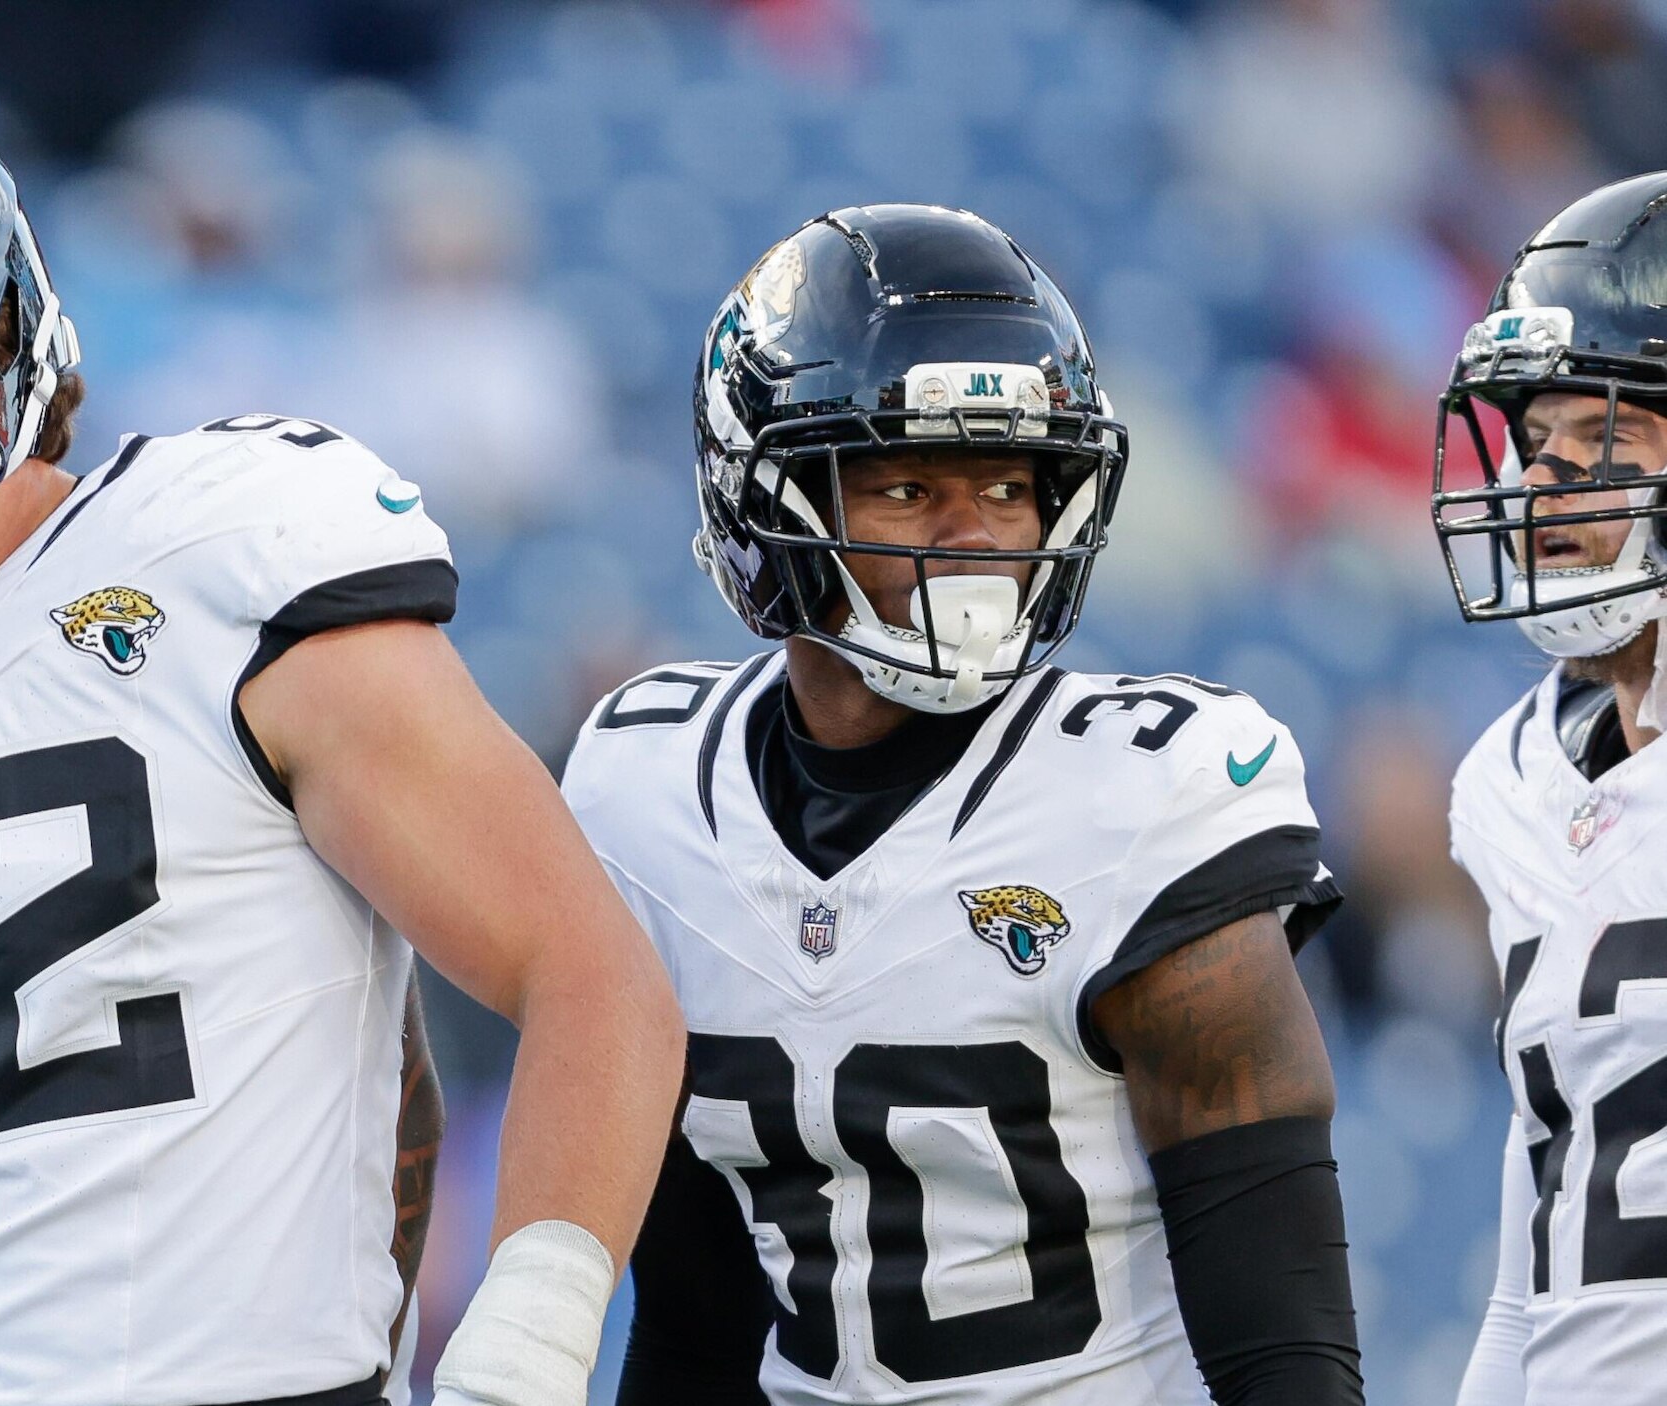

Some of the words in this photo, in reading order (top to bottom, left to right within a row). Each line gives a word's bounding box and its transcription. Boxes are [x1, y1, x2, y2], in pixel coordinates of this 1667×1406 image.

[964, 373, 1004, 397] JAX
[803, 926, 830, 951] NFL
[687, 1031, 1103, 1383] 30
